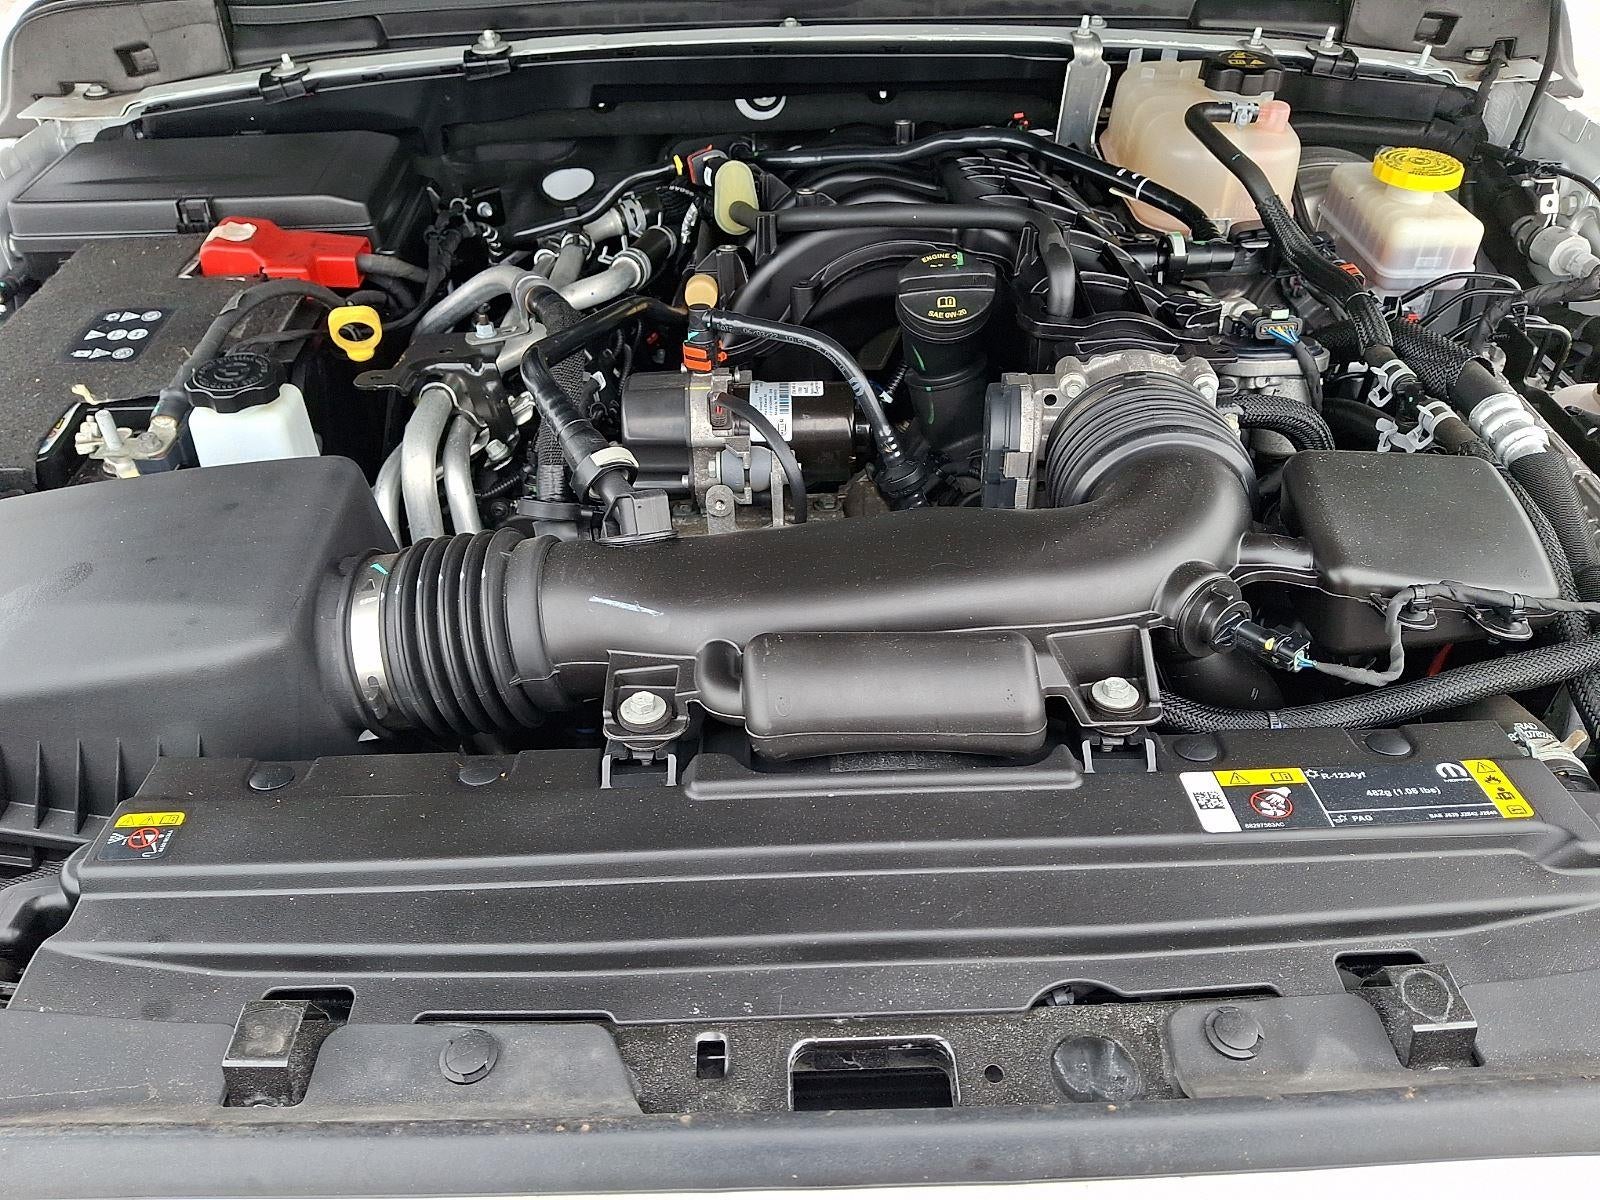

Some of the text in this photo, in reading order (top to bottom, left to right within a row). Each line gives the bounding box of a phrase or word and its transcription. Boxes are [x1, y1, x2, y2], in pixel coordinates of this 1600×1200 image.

[921, 252, 950, 263] ENGINE
[928, 308, 968, 319] SAE 0W-20
[1513, 722, 1538, 730] RAD
[1320, 771, 1367, 780] R-1234yf
[1351, 814, 1374, 822] PAG
